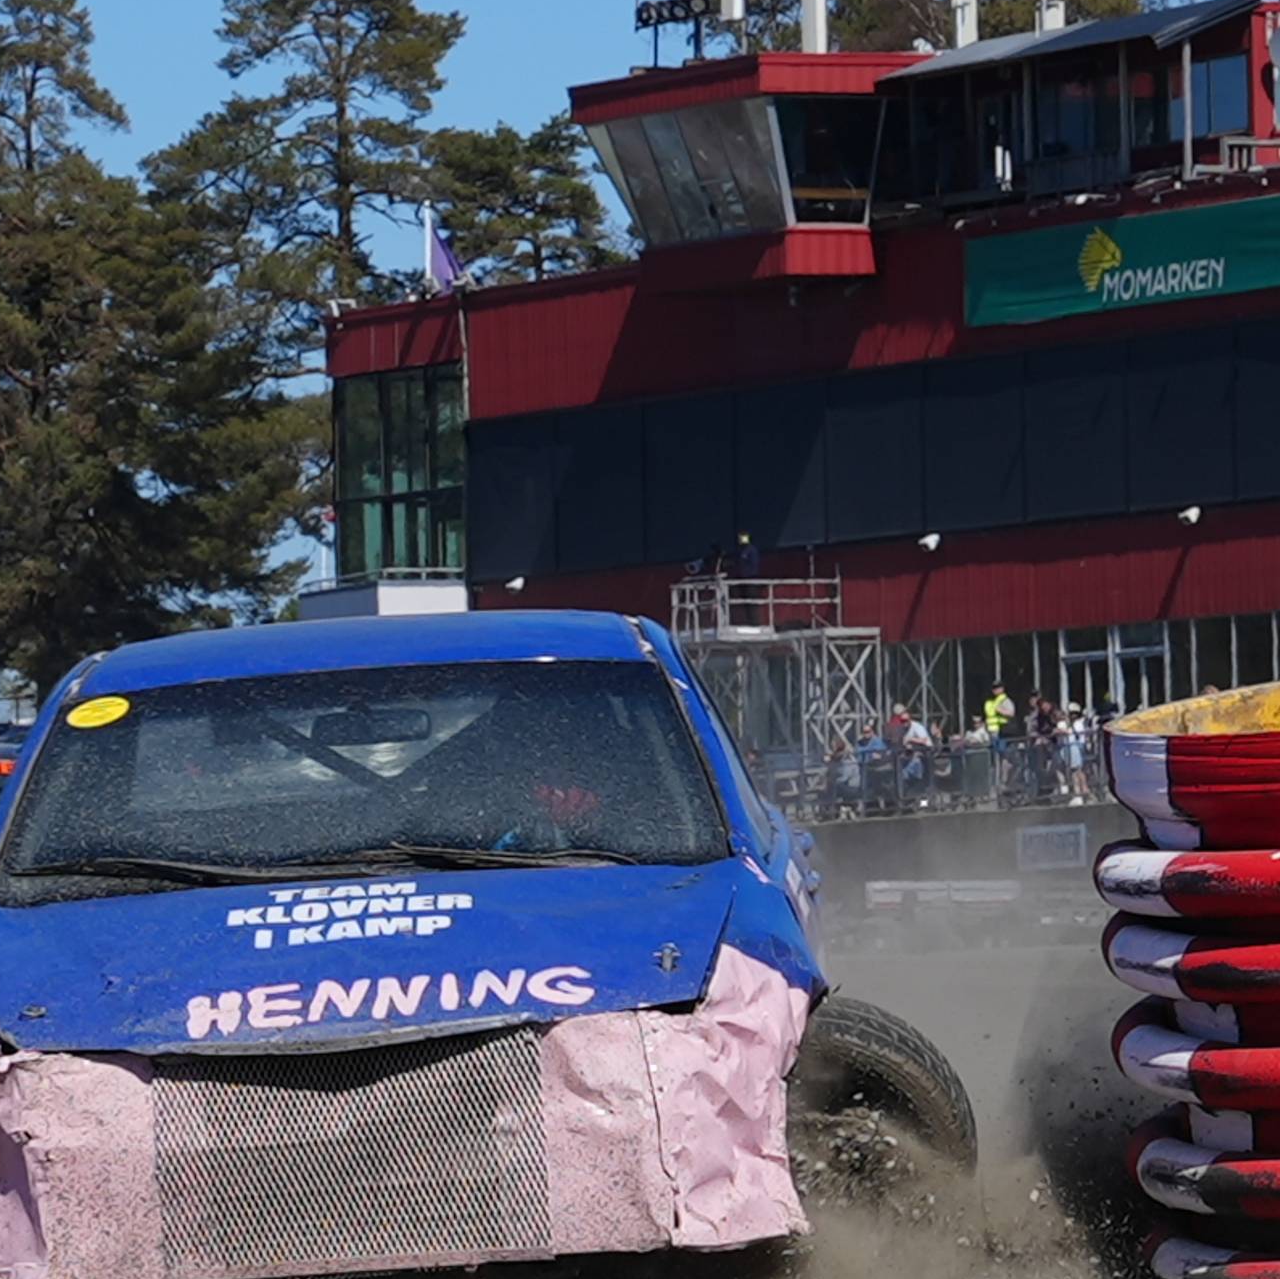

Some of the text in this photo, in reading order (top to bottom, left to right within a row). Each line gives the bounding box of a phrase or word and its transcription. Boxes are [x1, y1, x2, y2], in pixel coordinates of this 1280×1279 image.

[1103, 258, 1224, 301] MOMARKEN
[269, 882, 417, 903] TEAM
[227, 894, 473, 926] KLOVNER
[254, 916, 452, 949] I KAMP
[187, 966, 596, 1039] HENNING
